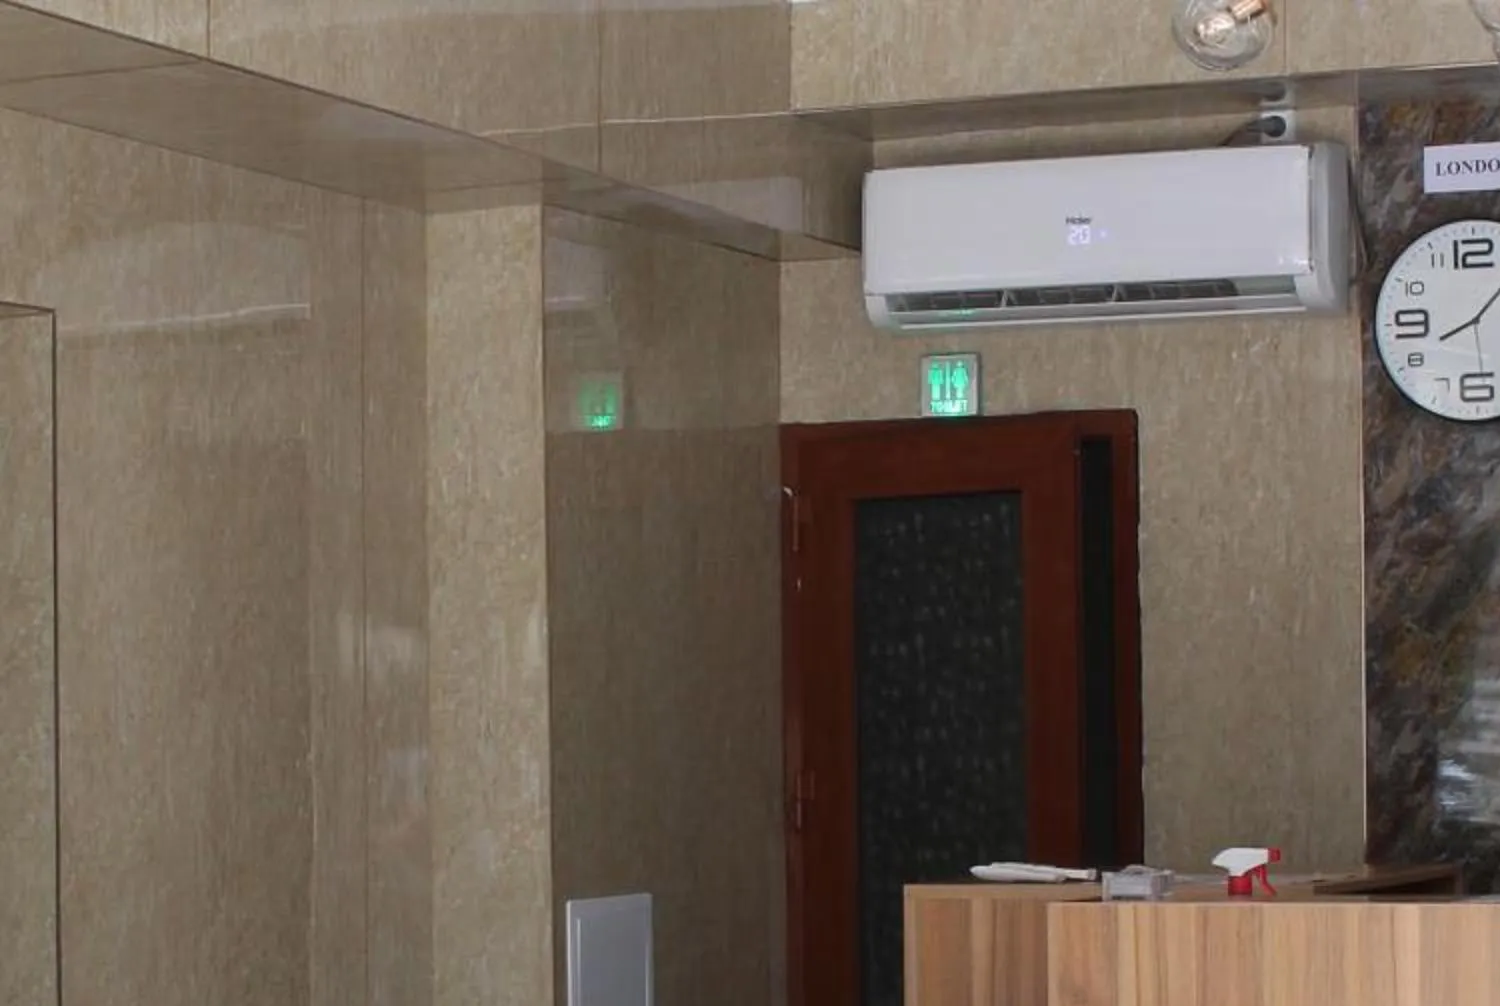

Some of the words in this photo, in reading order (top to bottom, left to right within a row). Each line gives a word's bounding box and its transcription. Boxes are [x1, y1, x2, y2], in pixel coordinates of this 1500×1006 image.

[1431, 252, 1444, 268] 11
[1453, 238, 1494, 269] 12
[1405, 281, 1424, 296] 10
[1395, 309, 1429, 339] 9
[1408, 353, 1424, 367] 8
[1435, 377, 1450, 391] 7
[1459, 372, 1494, 402] 6
